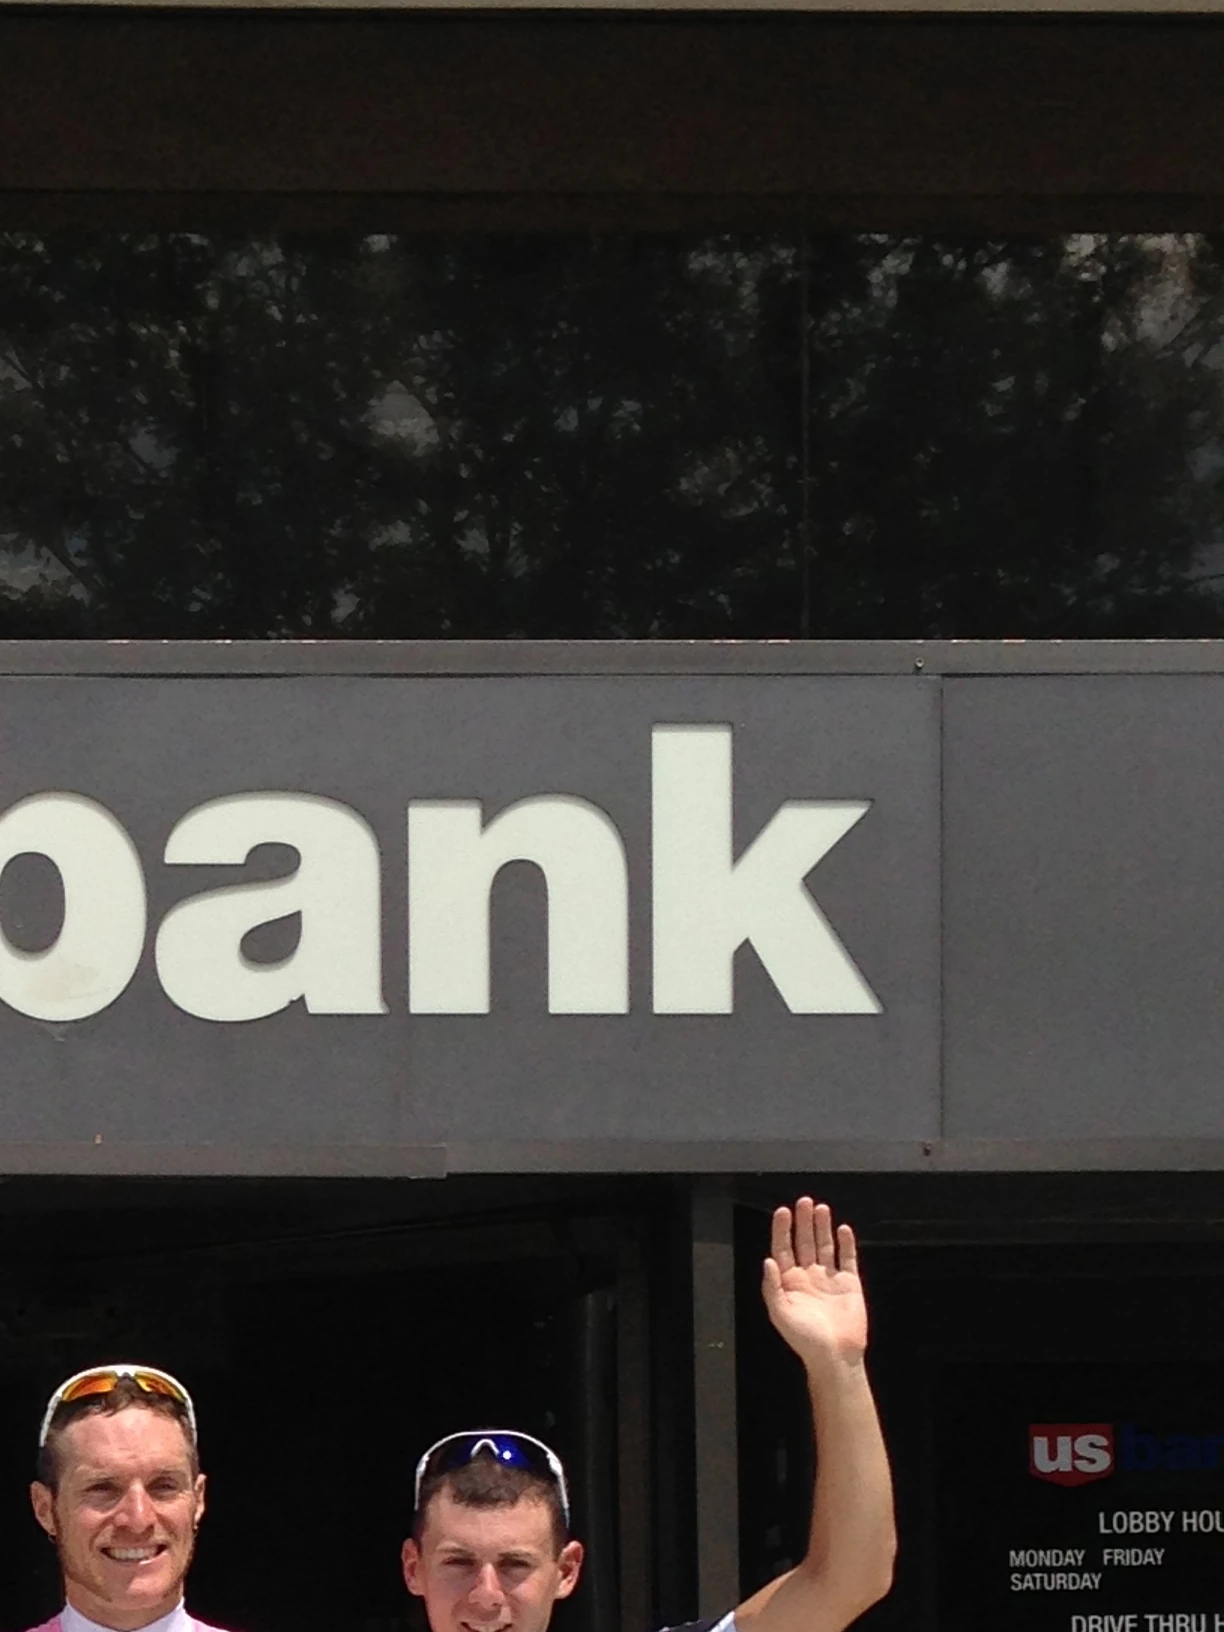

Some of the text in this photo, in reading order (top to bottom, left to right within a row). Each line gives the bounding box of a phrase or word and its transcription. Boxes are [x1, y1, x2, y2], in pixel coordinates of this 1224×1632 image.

[1033, 1433, 1112, 1474] us
[1099, 1511, 1175, 1534] LOBBY
[1009, 1548, 1165, 1568] MONDAY FRIDAY
[1010, 1573, 1102, 1592] SATURDAY
